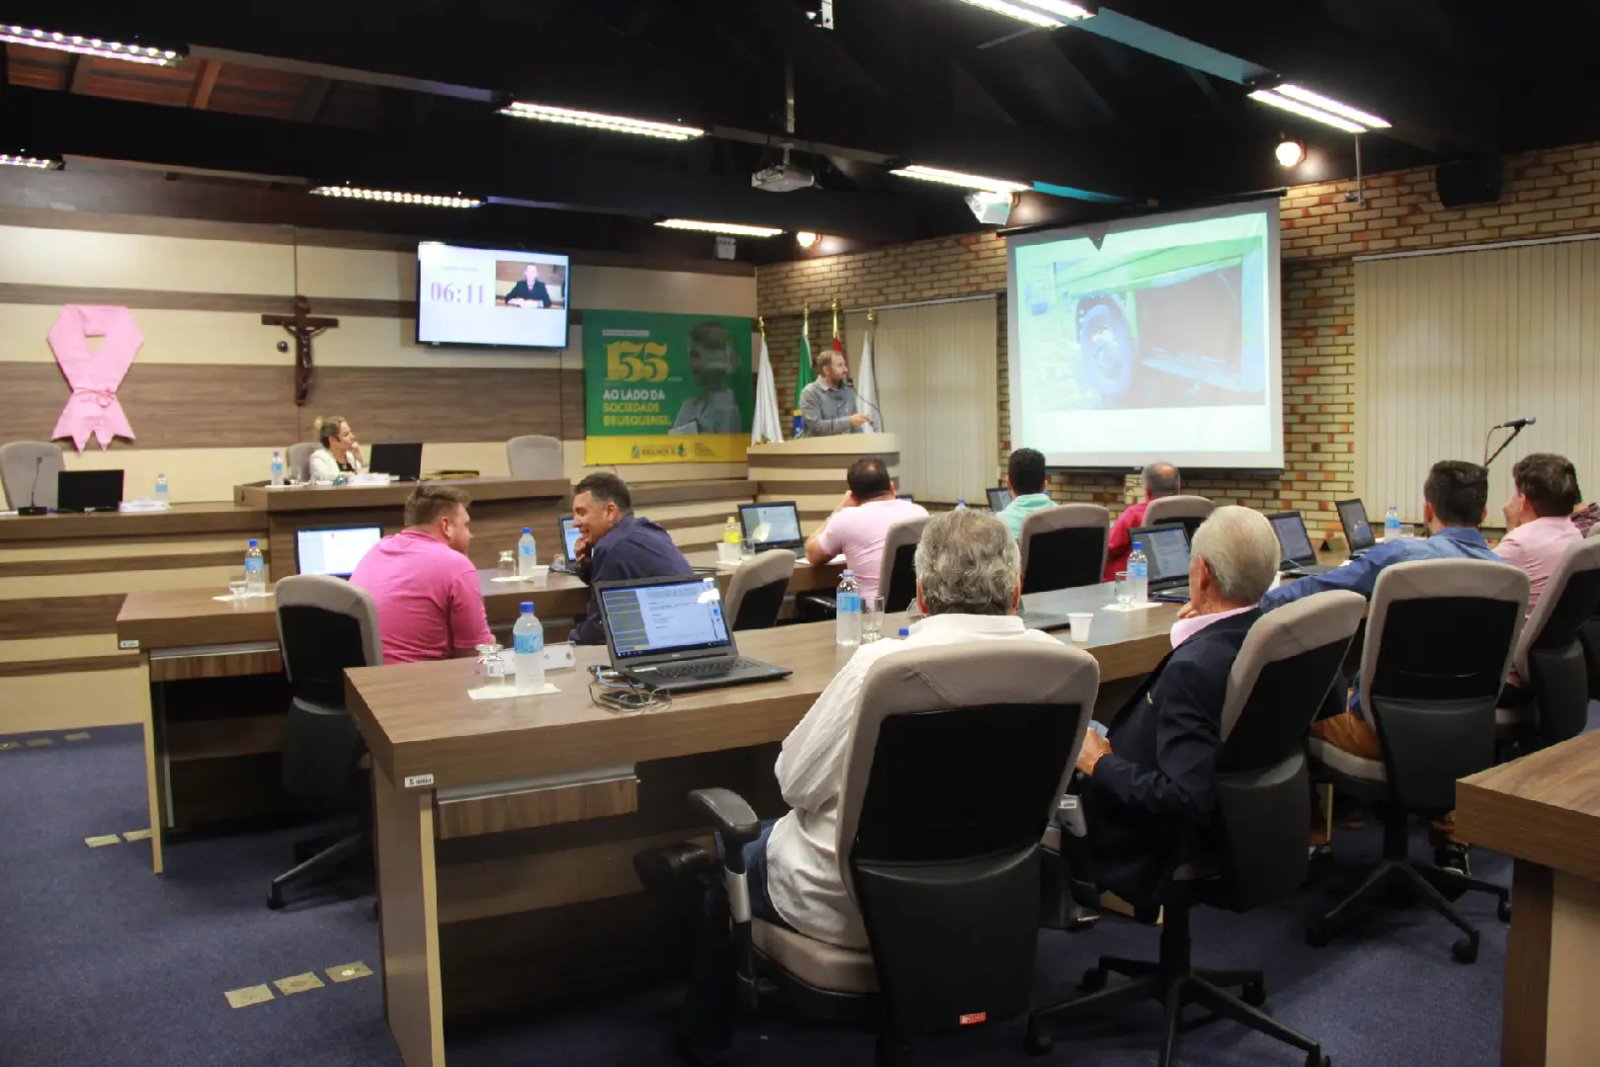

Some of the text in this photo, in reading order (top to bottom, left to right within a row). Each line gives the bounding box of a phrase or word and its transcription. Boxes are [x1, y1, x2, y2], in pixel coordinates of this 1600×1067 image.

[430, 281, 485, 304] 06:11
[605, 340, 669, 383] 155
[603, 389, 665, 400] AO LADO DA
